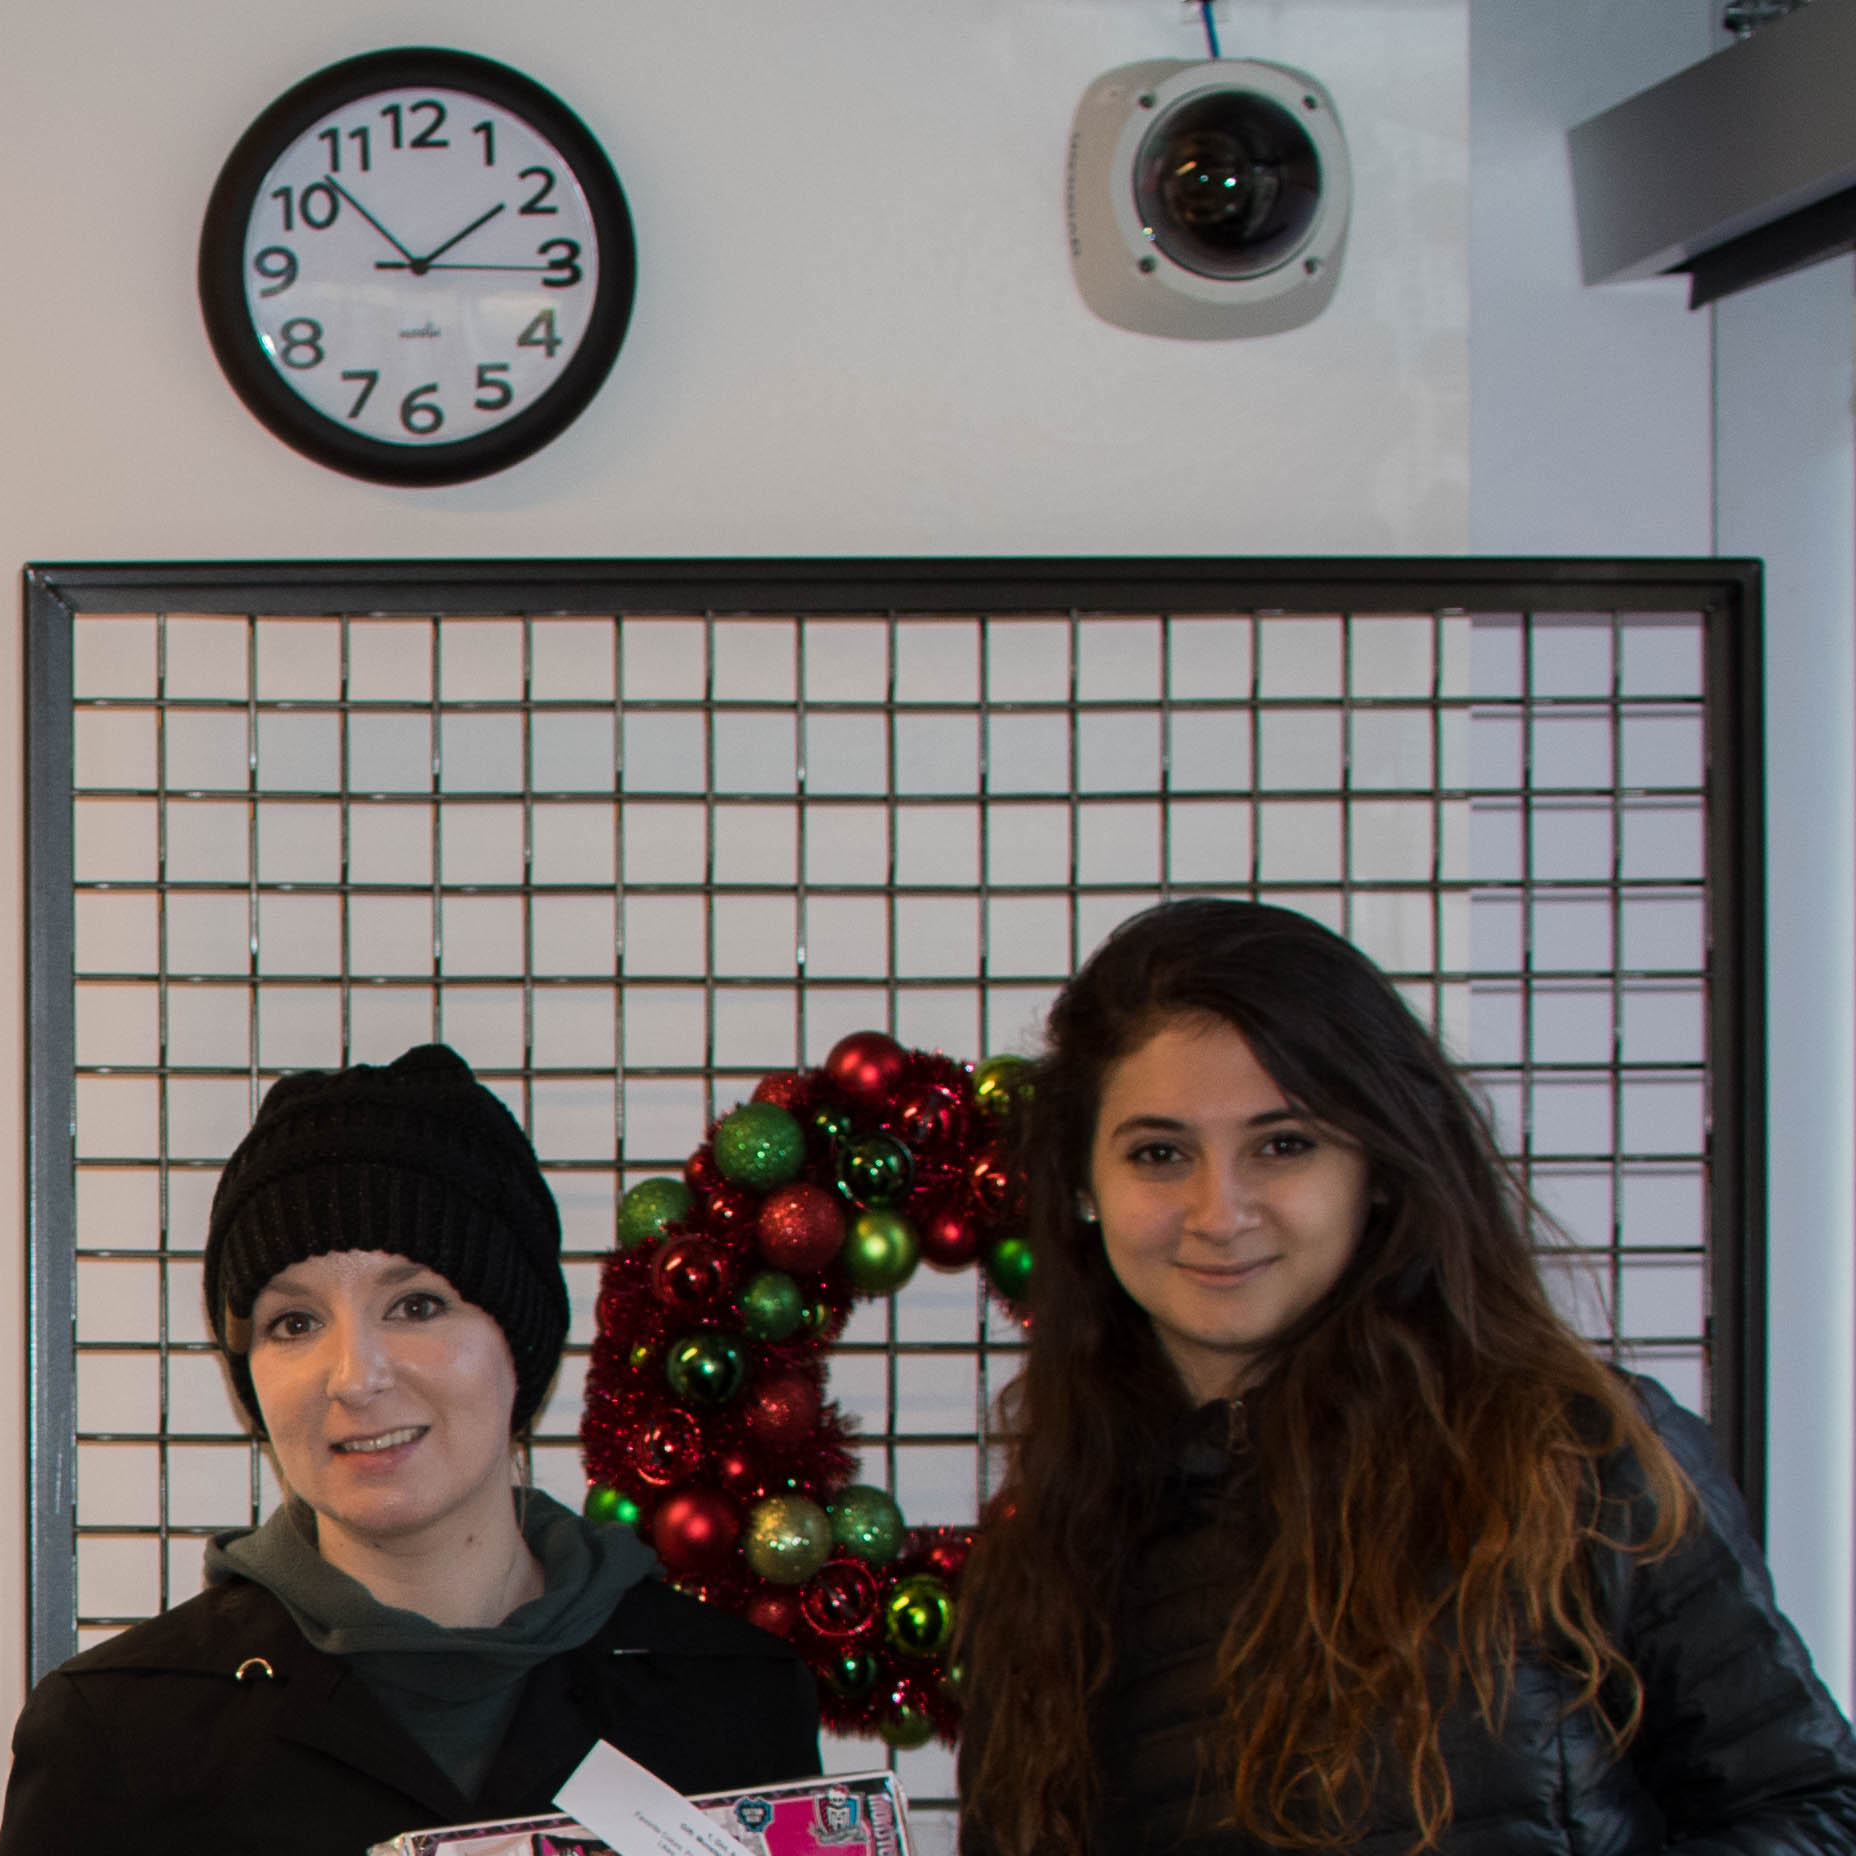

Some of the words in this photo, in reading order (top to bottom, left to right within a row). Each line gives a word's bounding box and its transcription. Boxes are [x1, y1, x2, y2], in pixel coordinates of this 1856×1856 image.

[379, 99, 449, 149] 12
[472, 120, 495, 166] 1
[318, 126, 371, 173] 11
[271, 181, 341, 232] 10
[518, 166, 559, 216] 2
[254, 246, 299, 299] 9
[536, 238, 583, 288] 3
[280, 317, 325, 370] 8
[516, 309, 562, 358] 4
[341, 369, 379, 419] 7
[400, 382, 445, 435] 6
[474, 362, 513, 411] 5
